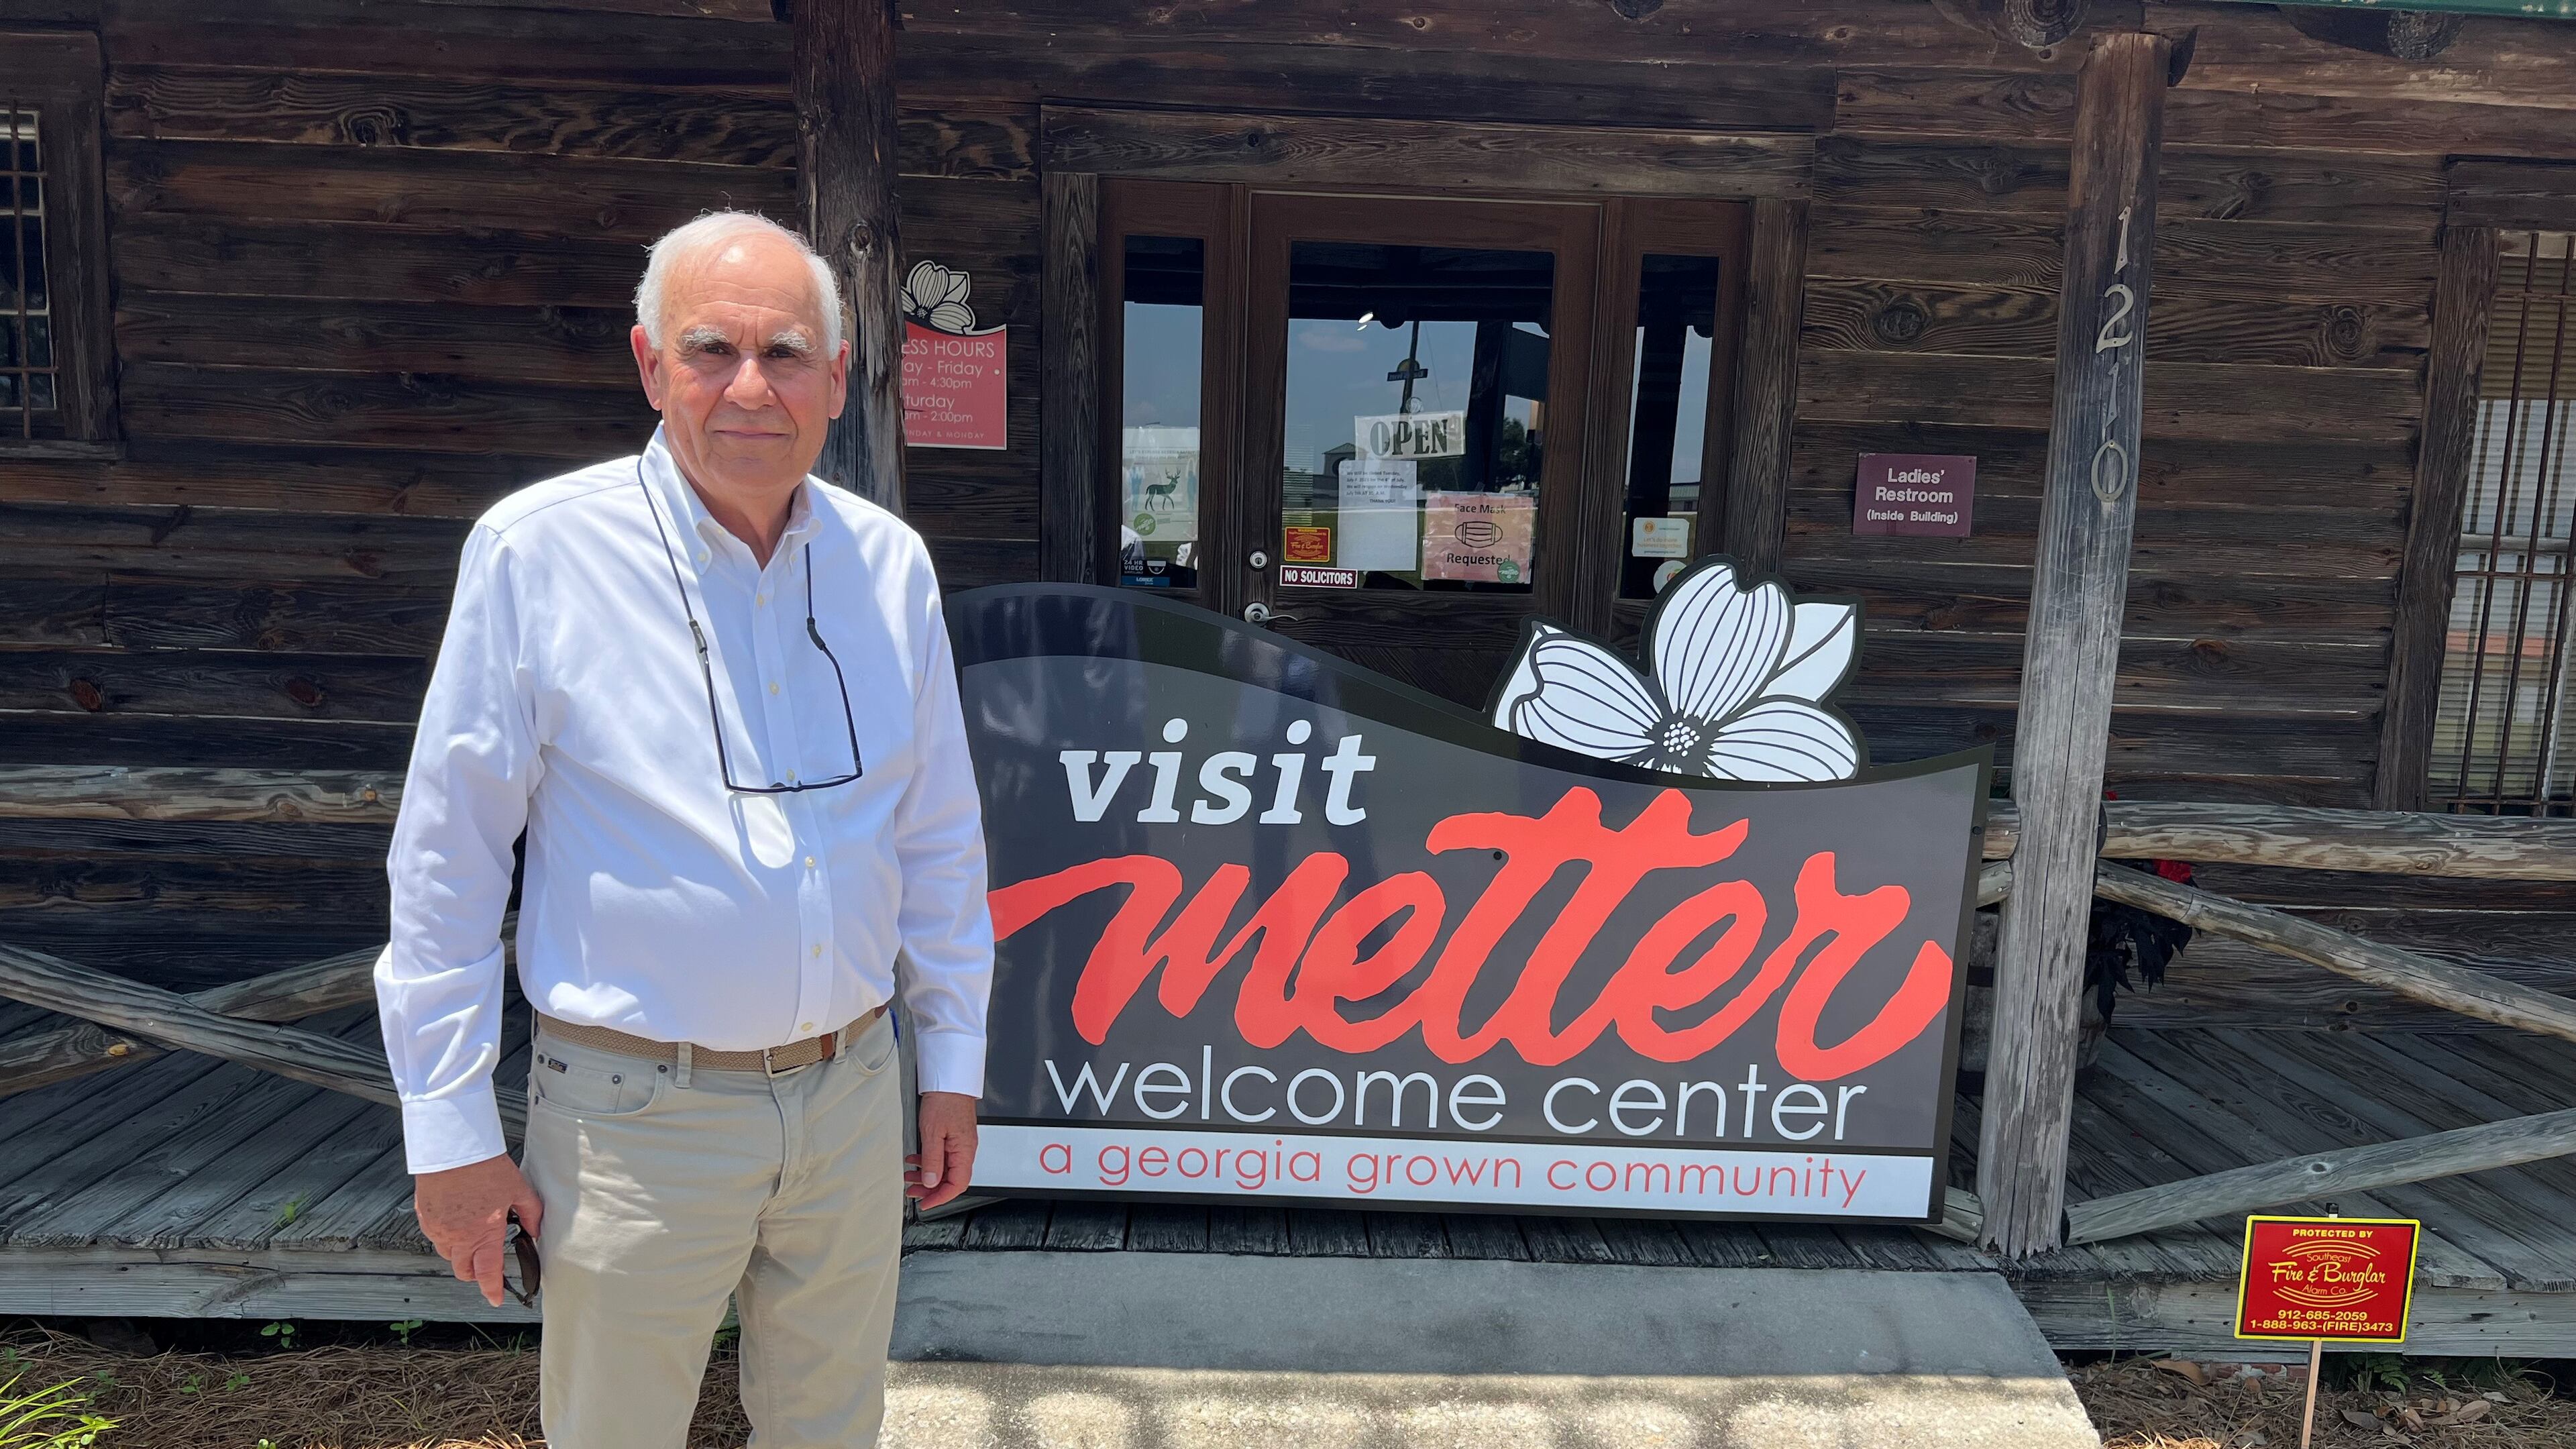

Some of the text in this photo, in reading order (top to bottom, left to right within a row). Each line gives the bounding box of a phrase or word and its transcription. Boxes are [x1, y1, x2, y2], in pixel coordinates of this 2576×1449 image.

[934, 340, 995, 358] HOURS
[938, 360, 983, 378] Friday
[930, 377, 971, 390] 4:30pm
[906, 394, 955, 411] turday
[931, 411, 973, 424] 2:00pm
[906, 429, 932, 437] NDAY
[946, 431, 985, 439] MONDAY
[1370, 419, 1448, 457] OPEN
[1887, 468, 1945, 484] Ladies'
[1875, 486, 1953, 503] Restroom
[1454, 503, 1507, 515] Face Mask
[1867, 508, 1958, 525] (Inside Building)
[1446, 553, 1510, 567] Requested
[1285, 570, 1353, 585] NO SOLICITORS
[1058, 718, 1377, 826] visit
[1044, 1044, 1868, 1140] welcome center
[1039, 1138, 1867, 1208] a georgia grown community
[2292, 1228, 2373, 1238] PROTECTED BY
[2306, 1252, 2352, 1263] Southeast
[2267, 1261, 2386, 1291] Fire & Burglar
[2302, 1284, 2347, 1295] Alarm Co.
[2277, 1309, 2367, 1321] 912-685-2059
[2250, 1320, 2394, 1333] 1-888-963-(FIRE)3473
